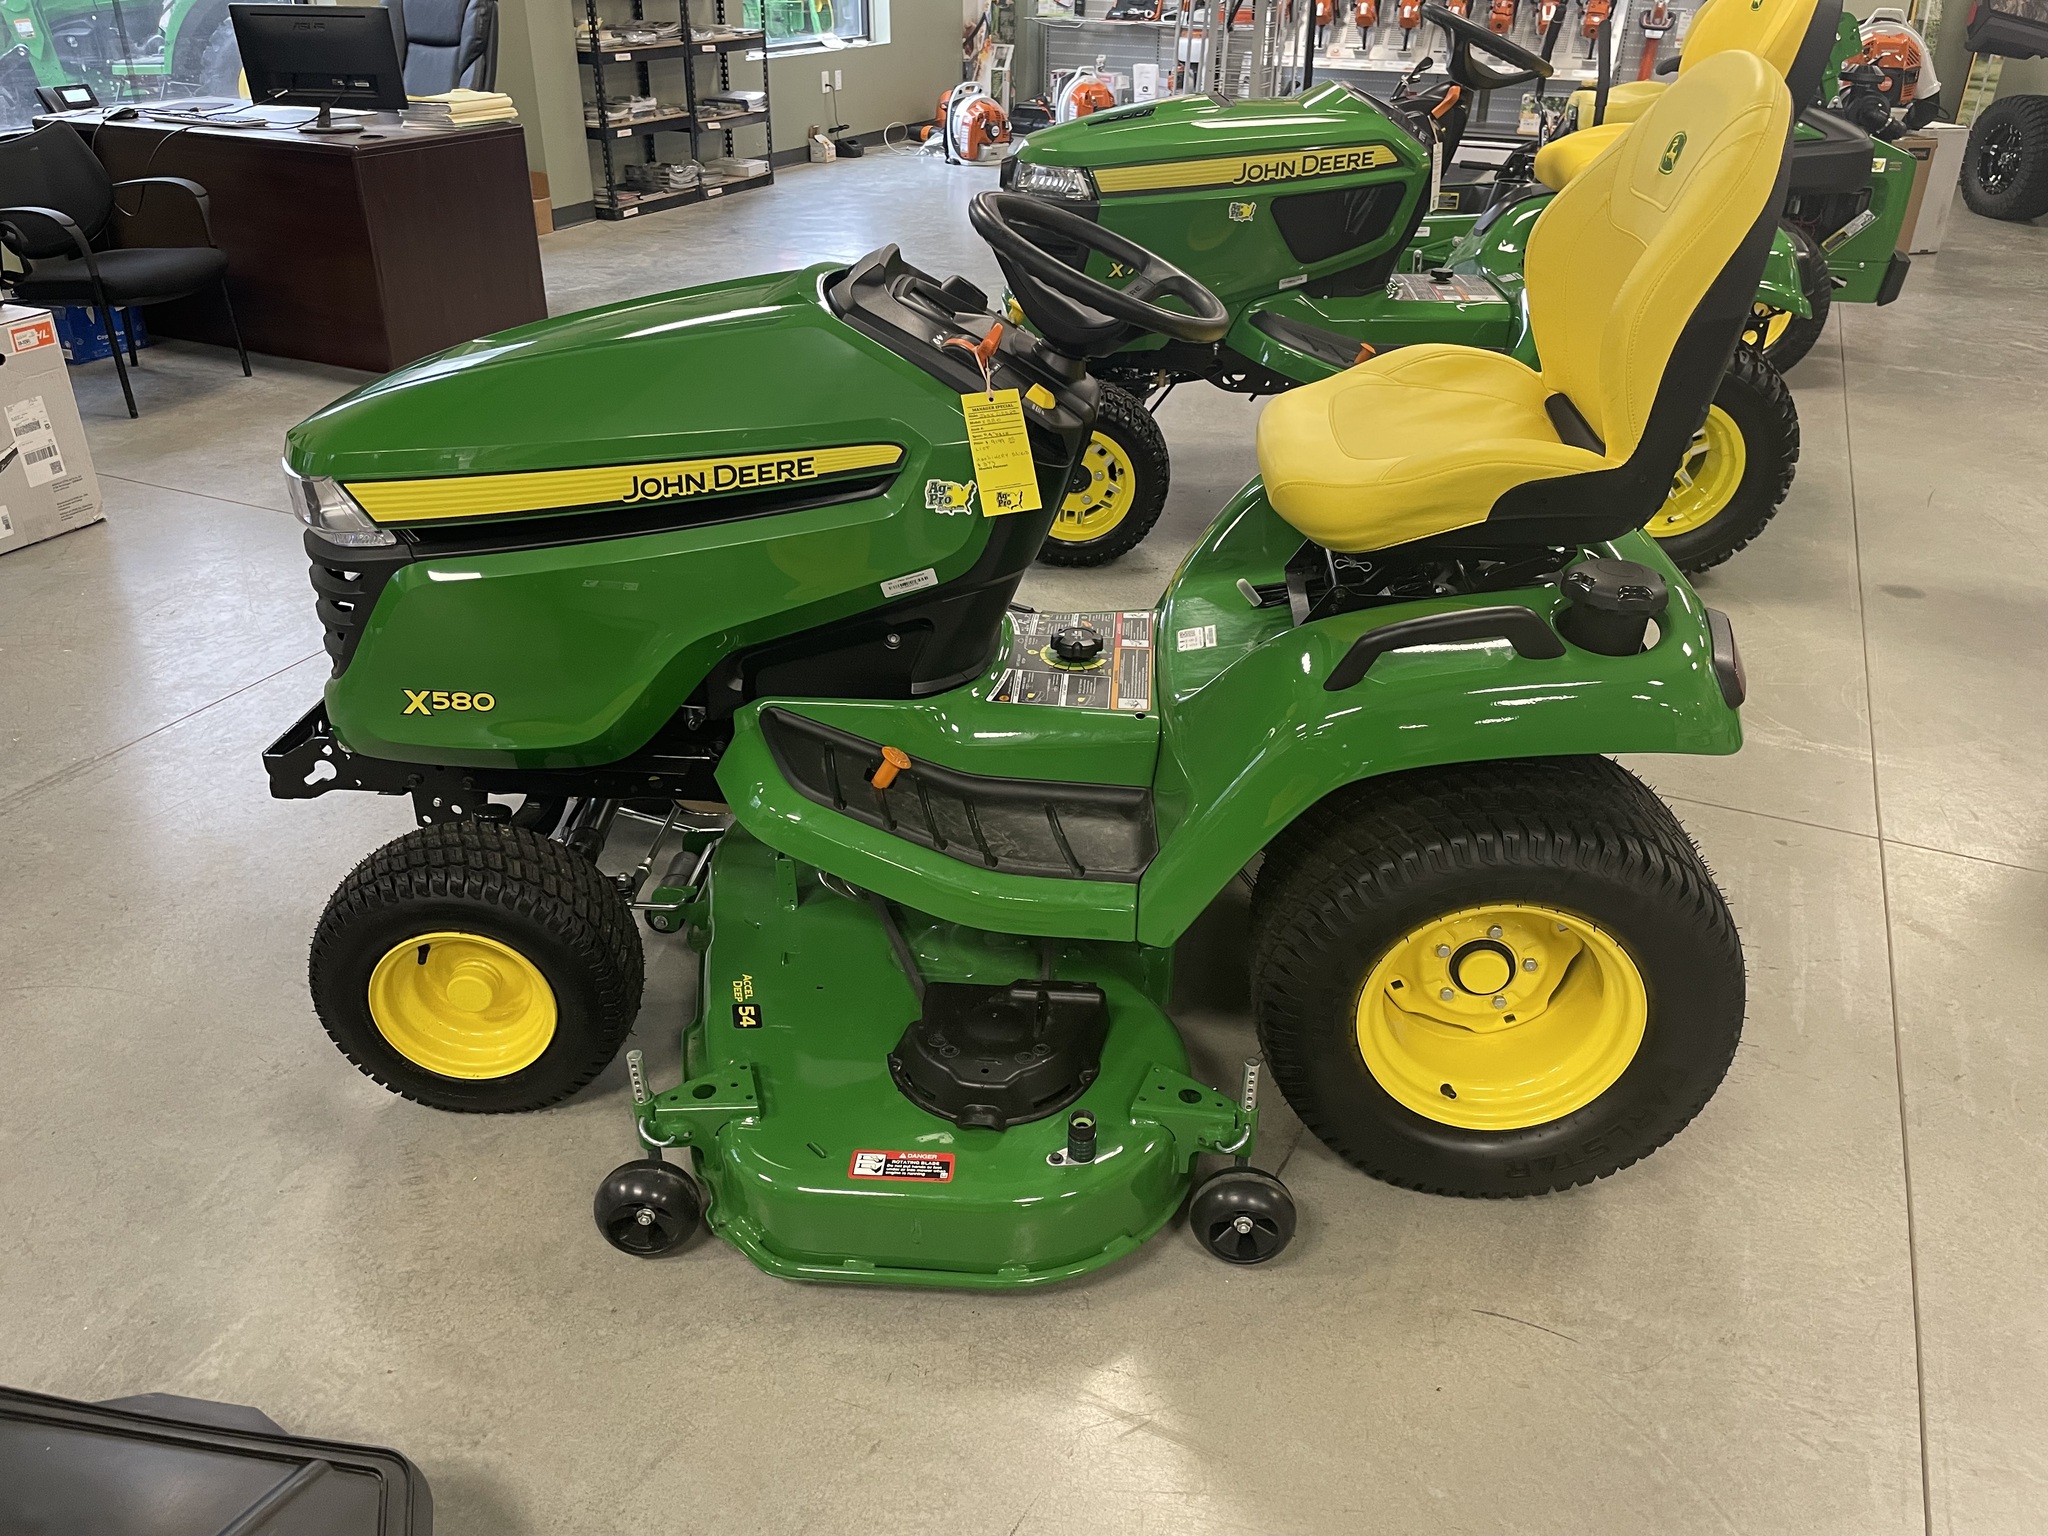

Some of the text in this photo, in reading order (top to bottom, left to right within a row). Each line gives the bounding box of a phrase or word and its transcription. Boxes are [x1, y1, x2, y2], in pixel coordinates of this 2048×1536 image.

[1234, 151, 1375, 183] JOHN DEERE
[622, 457, 815, 500] JOHN DEERE
[928, 481, 952, 494] Ag-
[928, 494, 952, 506] Pro
[997, 499, 1012, 507] Pro
[401, 689, 496, 716] X580
[732, 980, 743, 1003] DEEP
[742, 973, 753, 1000] ACCEL
[738, 1006, 757, 1028] 54
